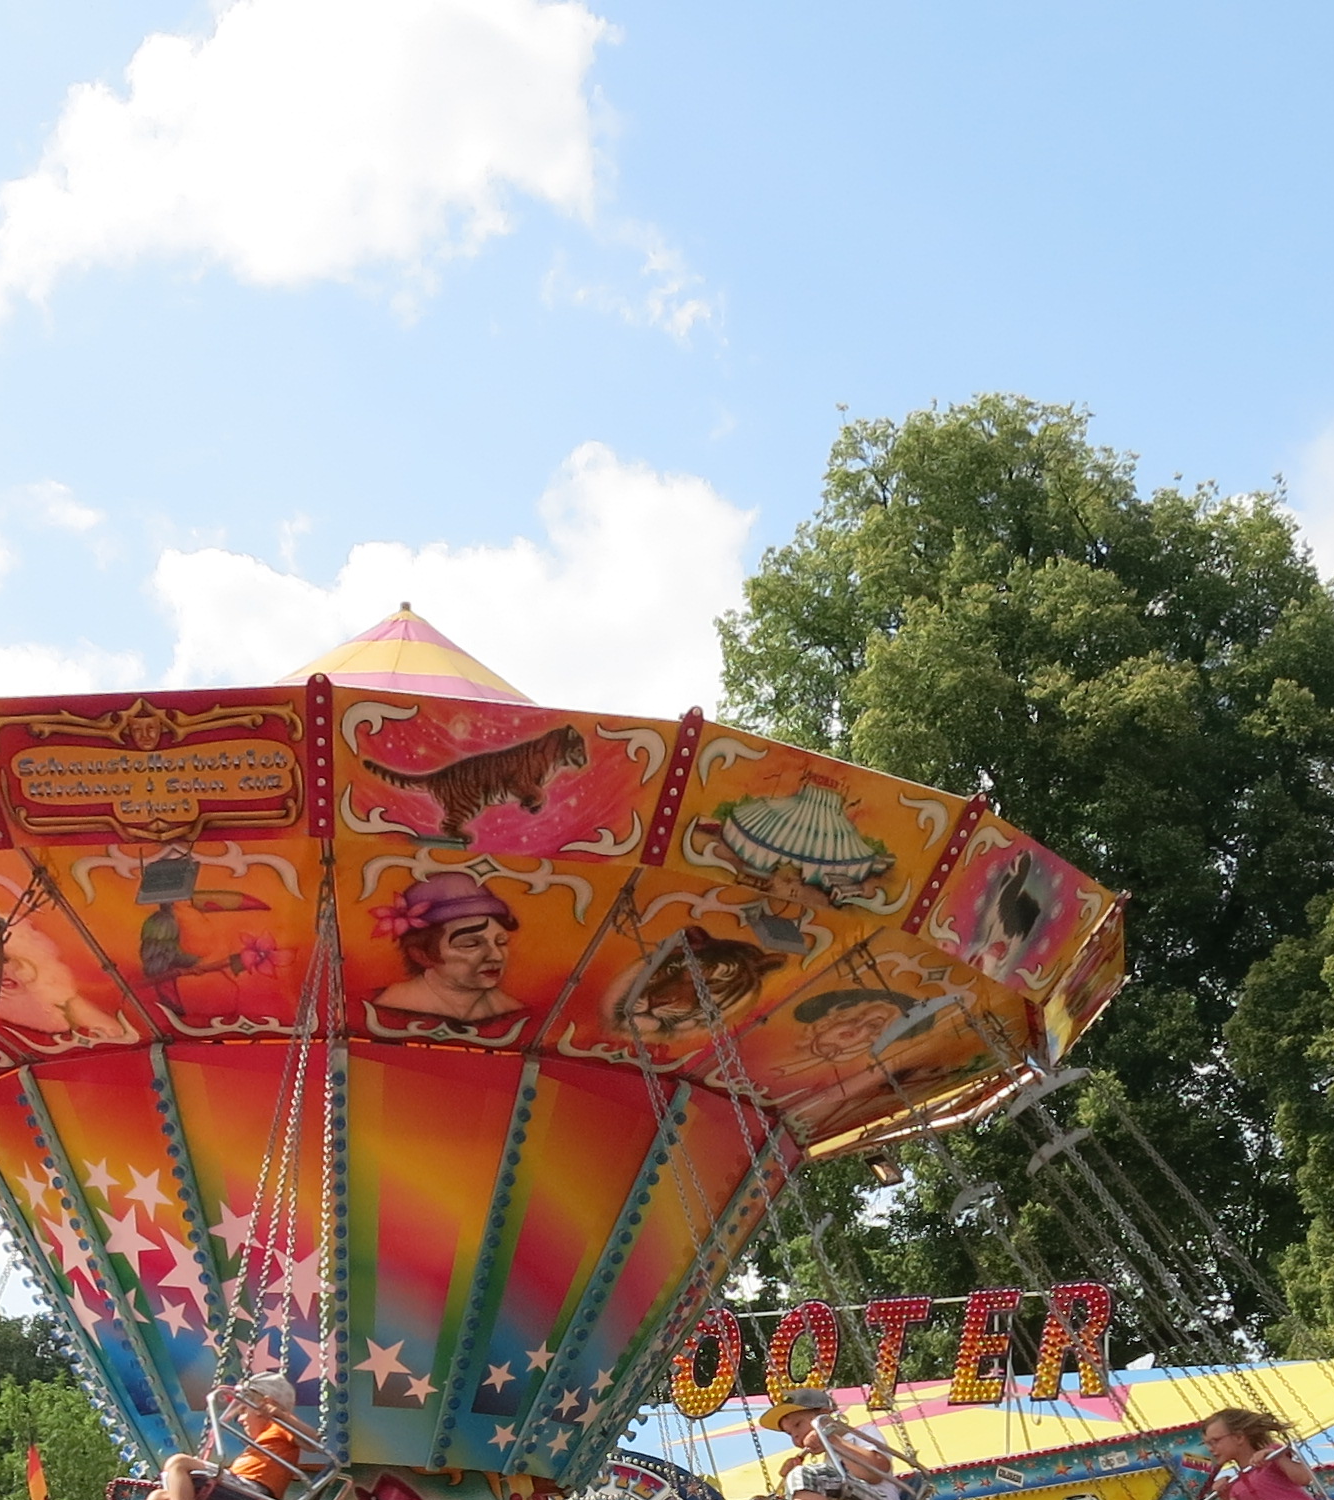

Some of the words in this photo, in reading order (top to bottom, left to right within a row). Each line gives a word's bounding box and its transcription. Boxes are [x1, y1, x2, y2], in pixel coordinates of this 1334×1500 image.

[18, 750, 289, 777] Schaustellerbetrieb
[28, 781, 133, 797] Kirchner
[167, 777, 227, 793] Sohn
[120, 798, 192, 819] Erfurt
